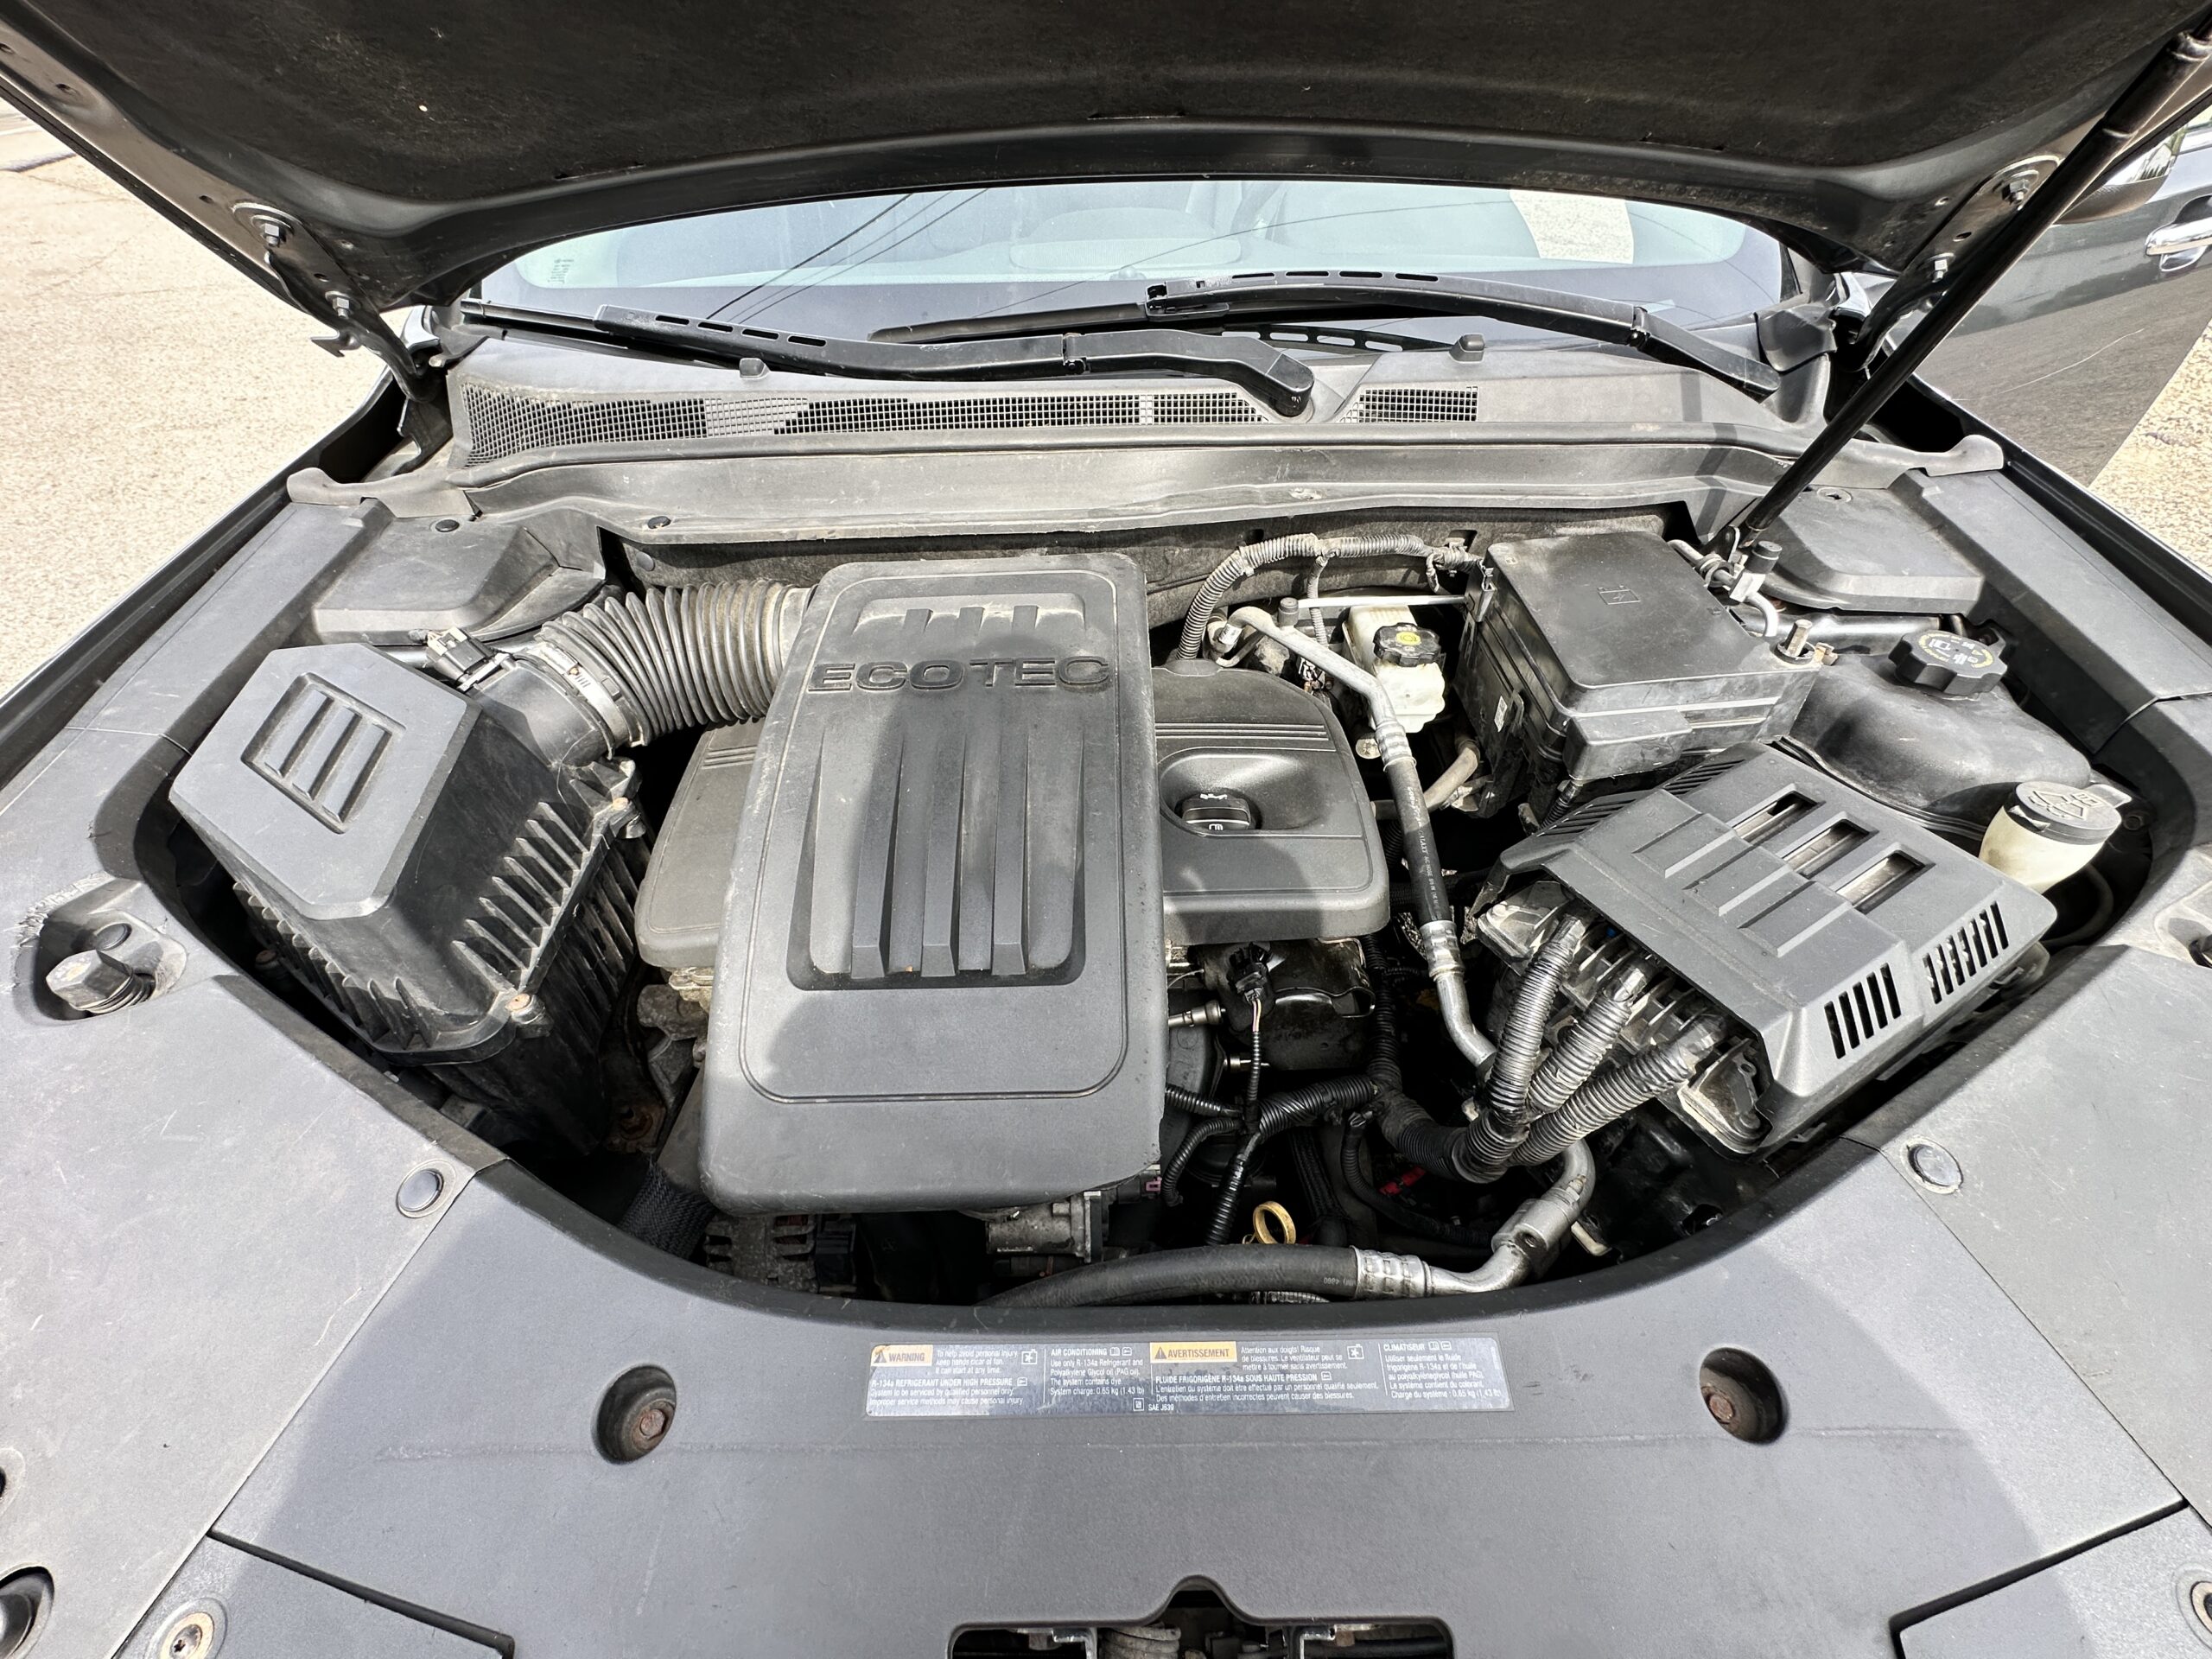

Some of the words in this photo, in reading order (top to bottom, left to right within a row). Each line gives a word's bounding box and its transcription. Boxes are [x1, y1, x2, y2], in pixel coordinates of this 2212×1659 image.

[808, 657, 1109, 692] ECOTEC
[889, 1352, 925, 1362] WARNING
[1168, 1349, 1230, 1358] AVERTISSEMENT
[981, 1377, 1012, 1386] PRESSURE
[1073, 1388, 1094, 1396] charge:
